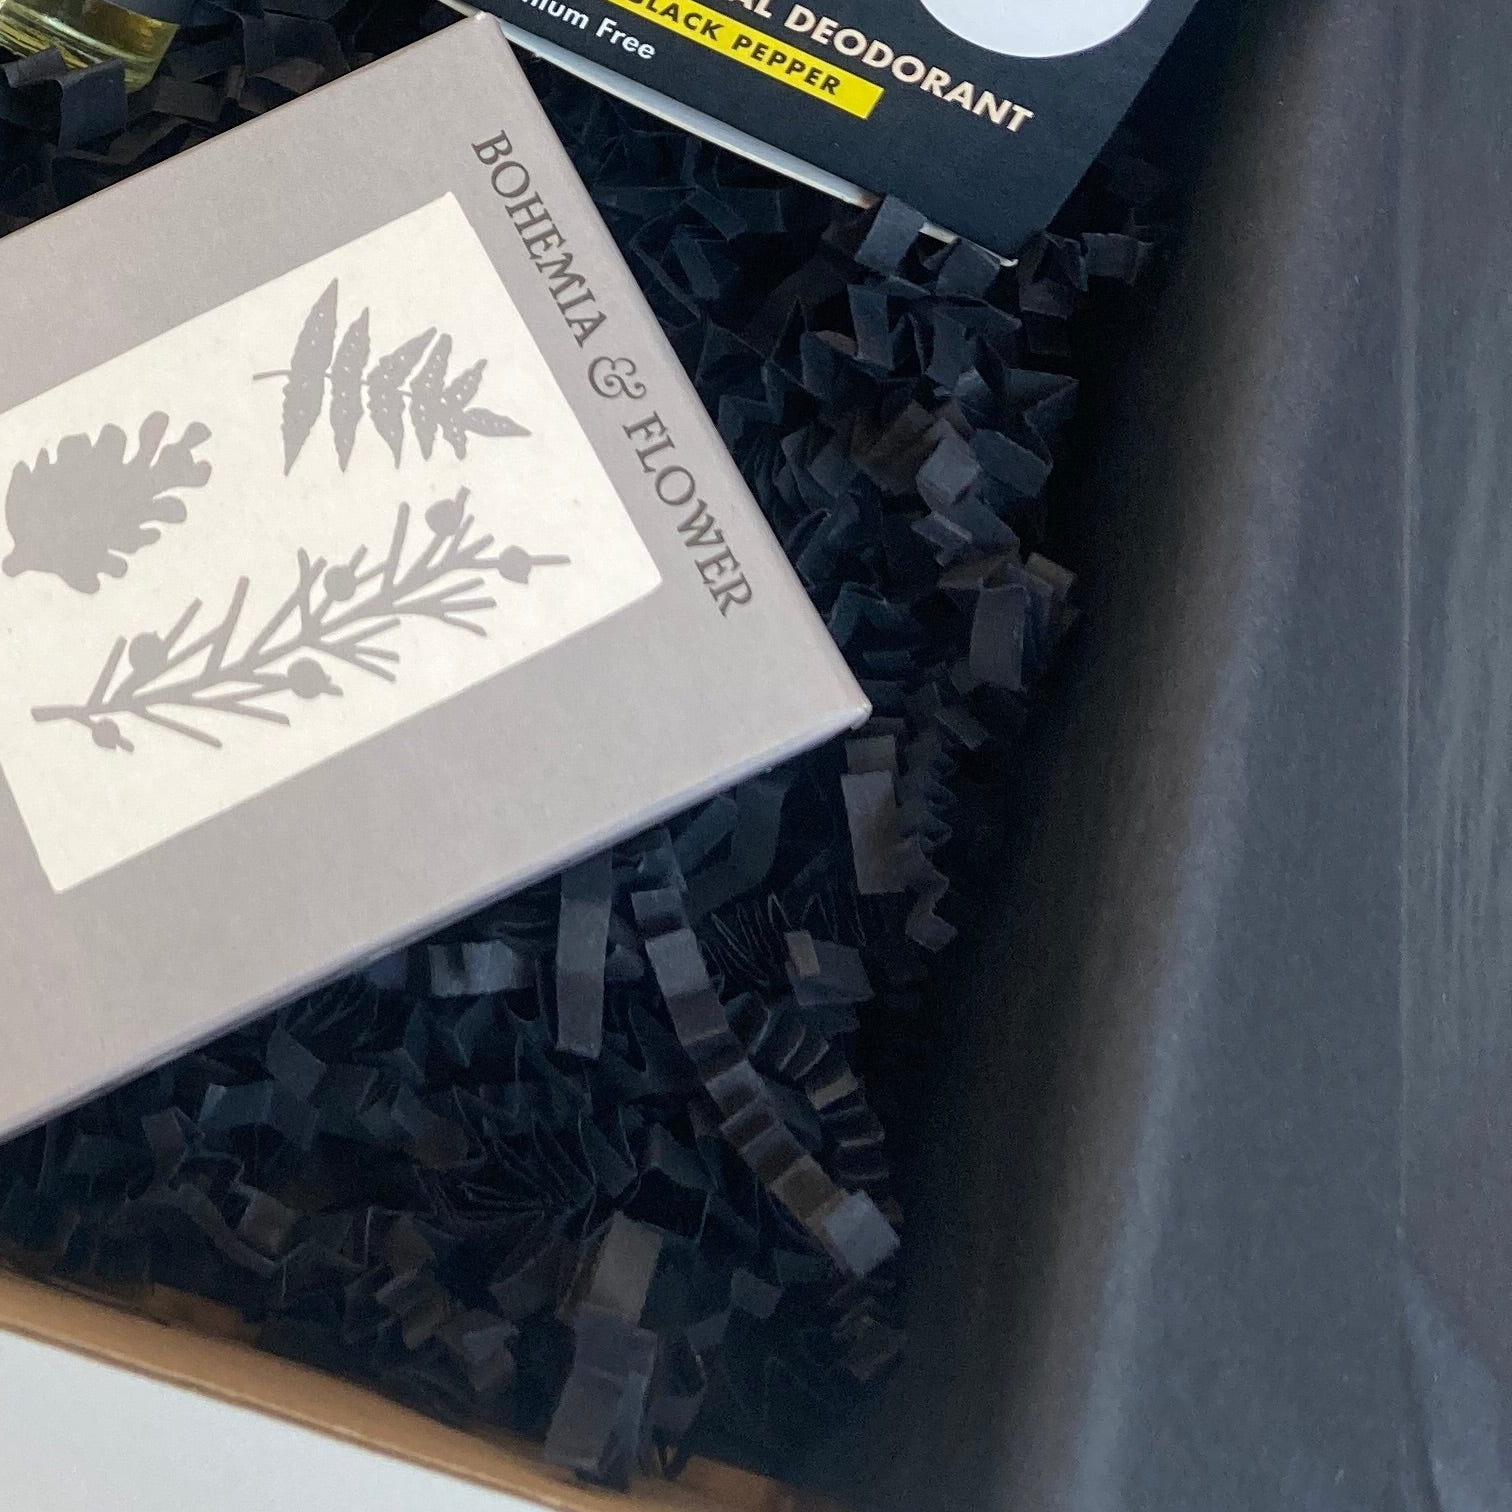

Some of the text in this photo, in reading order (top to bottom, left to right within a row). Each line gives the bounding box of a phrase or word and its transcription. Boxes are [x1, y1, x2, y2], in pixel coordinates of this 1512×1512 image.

[595, 18, 655, 59] Free
[731, 34, 841, 96] PEPPER
[784, 4, 1034, 133] DEODORANT
[471, 129, 753, 617] BOHEMIA & FLOWER
